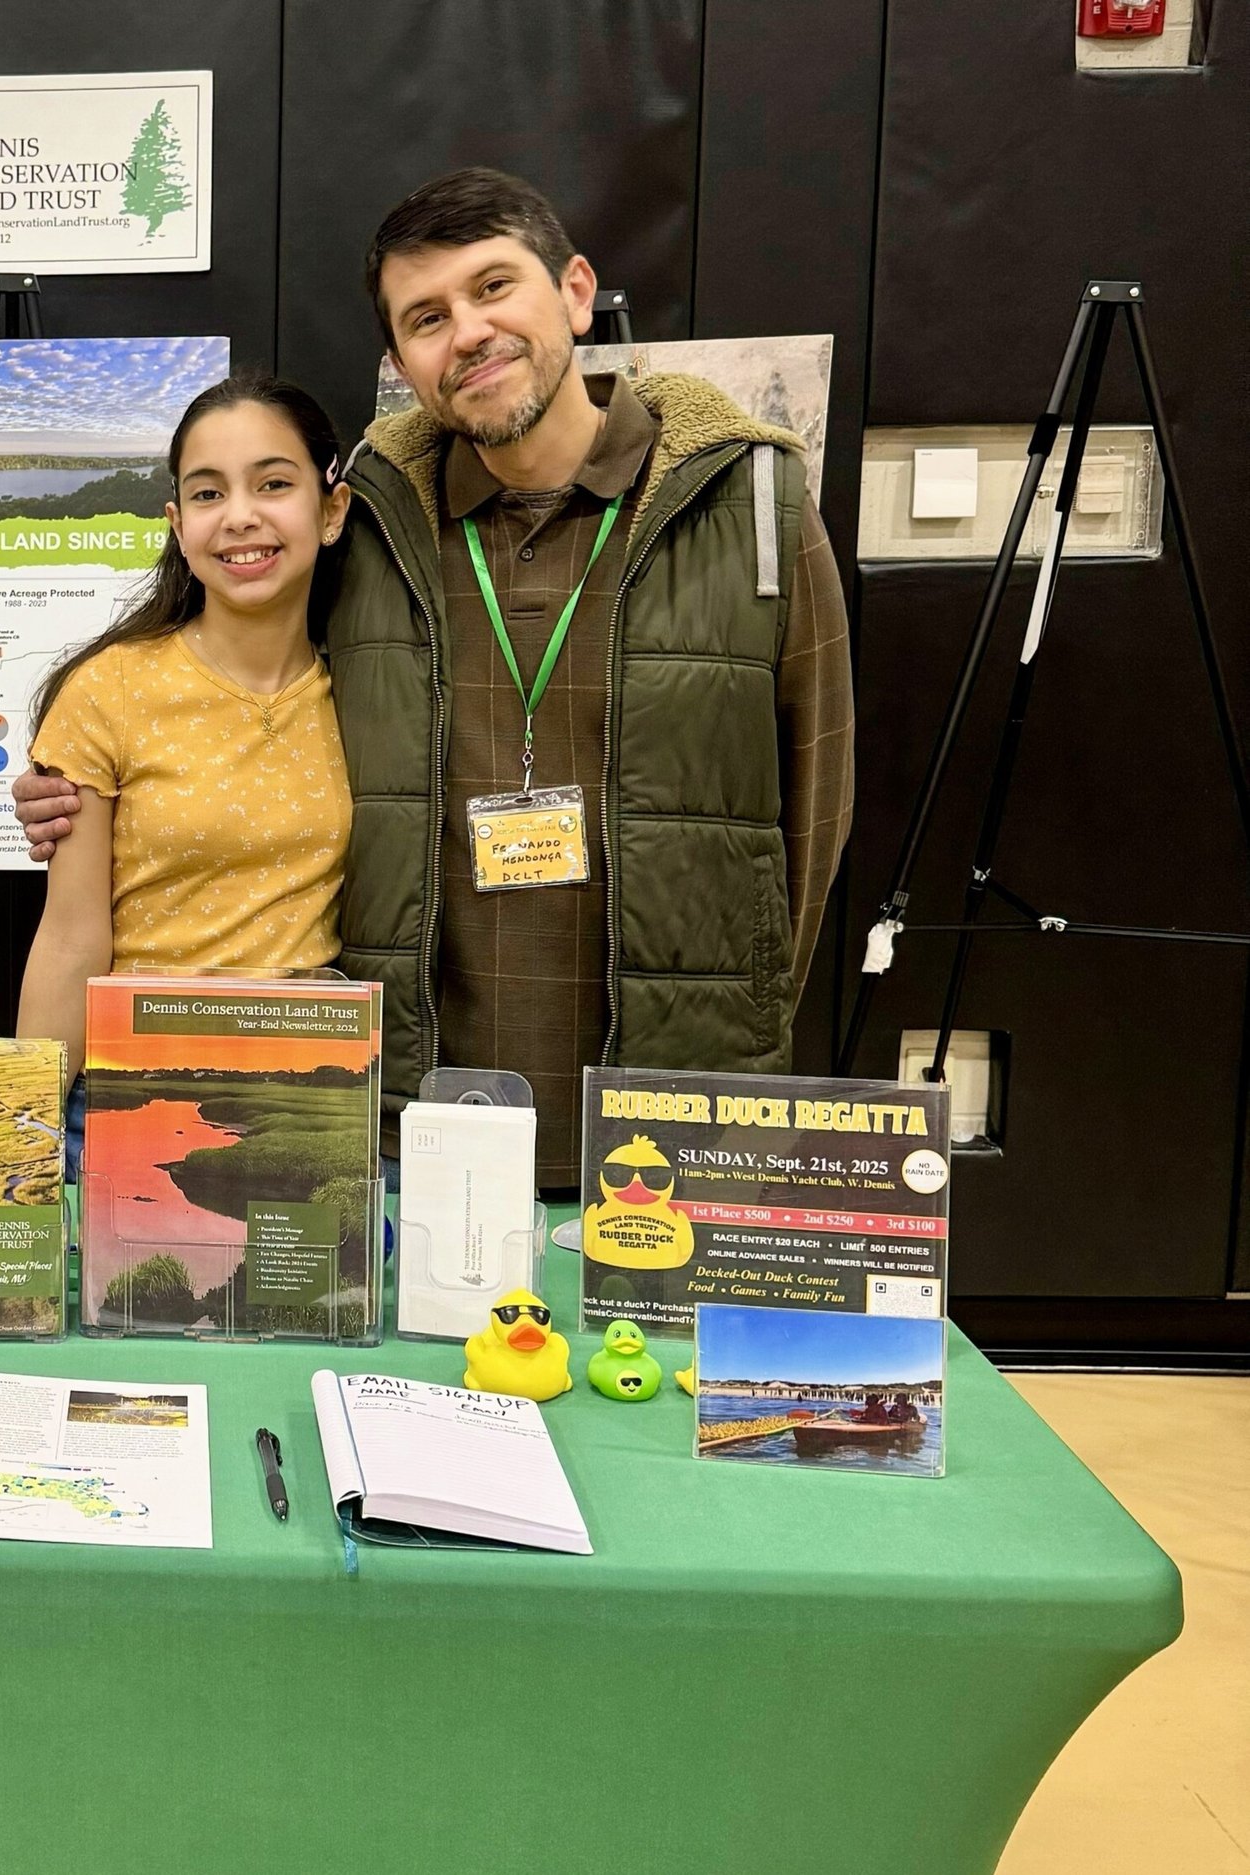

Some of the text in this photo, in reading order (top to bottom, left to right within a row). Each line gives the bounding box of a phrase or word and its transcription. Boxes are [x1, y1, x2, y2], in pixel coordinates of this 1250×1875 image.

[24, 190, 101, 210] TRUST
[0, 532, 60, 550] LAND
[68, 532, 134, 550] SINCE
[9, 590, 47, 600] Acreage
[51, 589, 94, 598] Protected
[503, 870, 543, 882] DCLT
[142, 1001, 358, 1019] Dennis Conservation Land Trust
[237, 1019, 358, 1034] Year-End Newsletter, 2024
[601, 1089, 928, 1136] RUBBER DUCK REGATTA
[678, 1149, 888, 1175] SUNDAY, Sept. 21st, 2025
[679, 1168, 724, 1180] 11am-2pm
[732, 1171, 754, 1180] West
[758, 1173, 788, 1183] Dennis
[792, 1175, 818, 1185] Yacht
[848, 1178, 861, 1187] W.
[864, 1179, 895, 1190] Dennis
[693, 1206, 935, 1232] 1st Place $500 2nd $250 3rd $100
[0, 1240, 33, 1249] TRUST
[713, 1233, 929, 1256] RACE ENTRY $20 EACH LIMIT 500 ENTRIES
[0, 1261, 28, 1272] Special
[29, 1261, 52, 1270] Places
[696, 1266, 839, 1286] Decked-Out Duck Contest
[11, 1275, 26, 1283] MA
[688, 1281, 845, 1302] Food Games Family Fun
[347, 1376, 417, 1391] EMAIL
[429, 1386, 529, 1409] SIGN-UP
[361, 1388, 410, 1398] NAME
